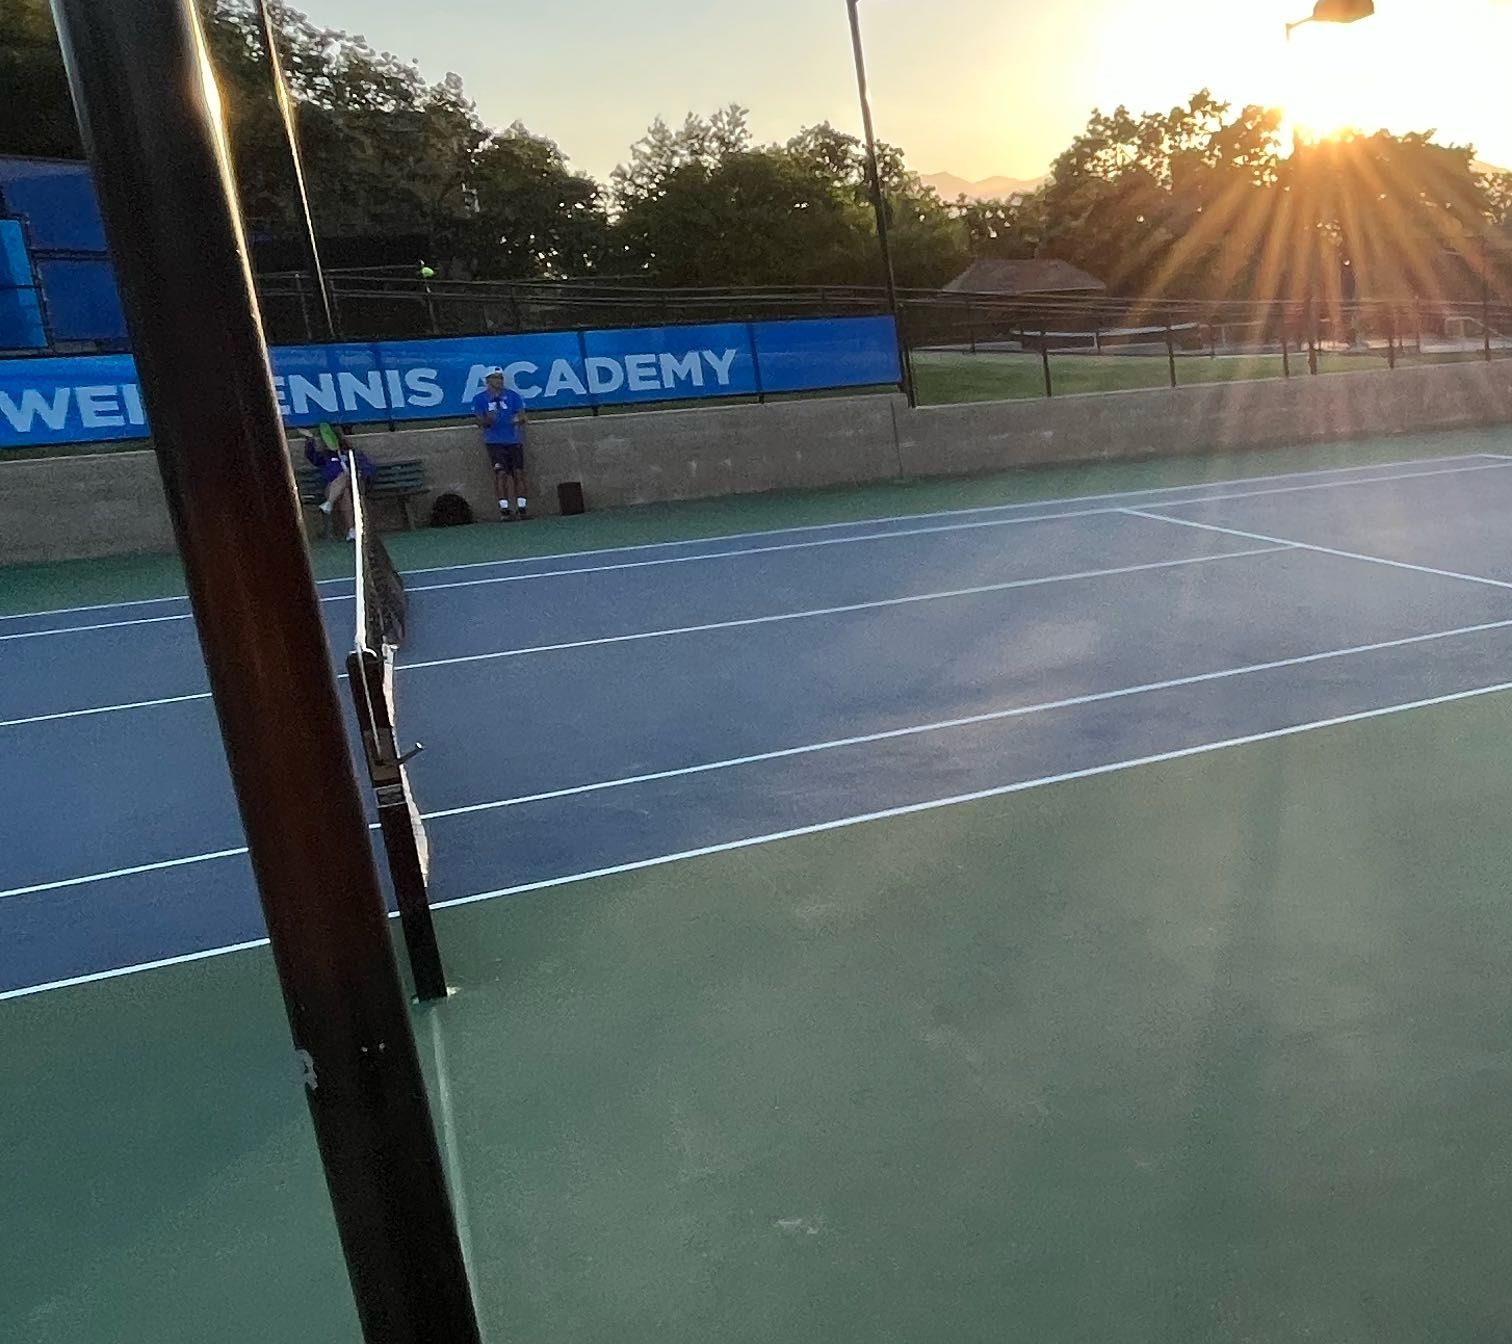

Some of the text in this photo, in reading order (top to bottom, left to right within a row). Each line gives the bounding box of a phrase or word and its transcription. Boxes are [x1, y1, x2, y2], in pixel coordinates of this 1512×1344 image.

[0, 348, 737, 433] WEI NNIS ACADEMY
